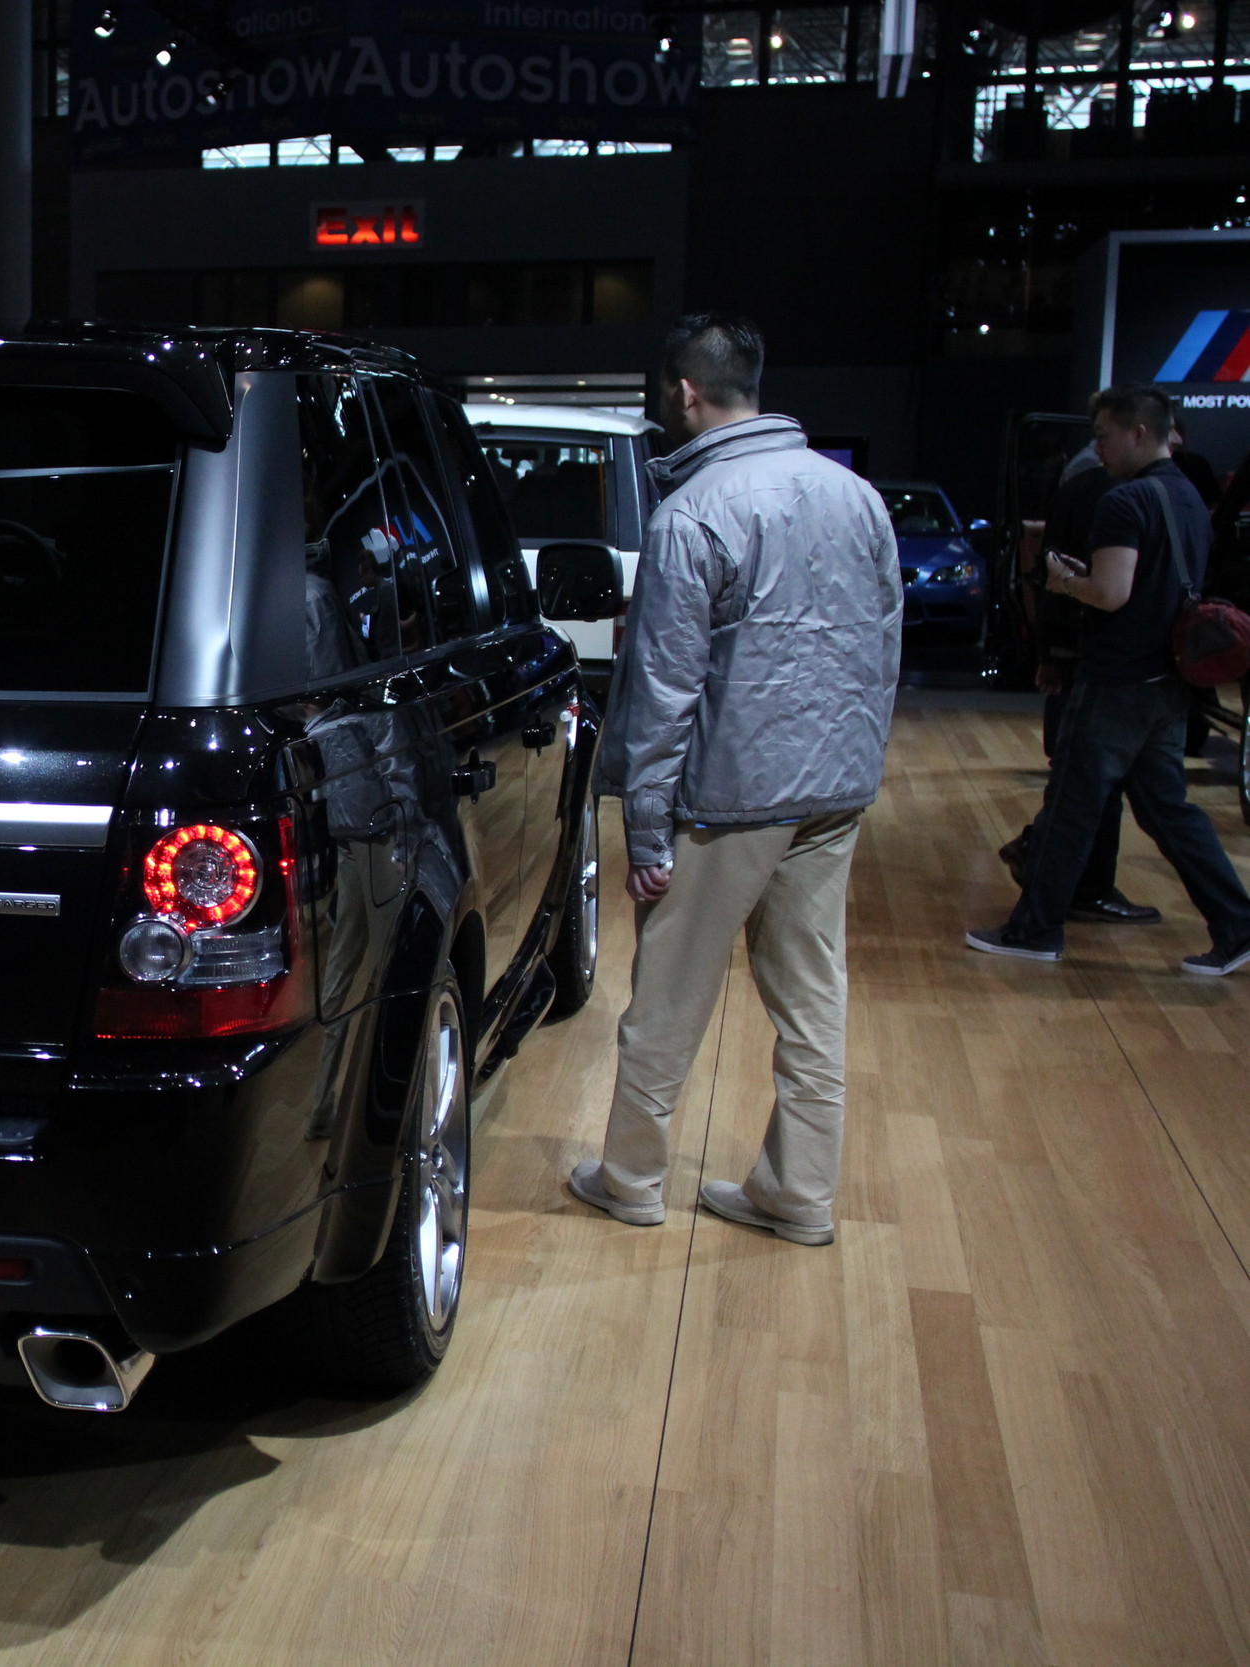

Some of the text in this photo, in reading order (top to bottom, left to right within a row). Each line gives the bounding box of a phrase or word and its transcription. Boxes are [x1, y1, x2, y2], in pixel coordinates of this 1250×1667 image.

[343, 36, 697, 106] Autoshow
[315, 205, 420, 245] Exit
[1183, 394, 1225, 408] MOST
[1226, 394, 1250, 408] PO
